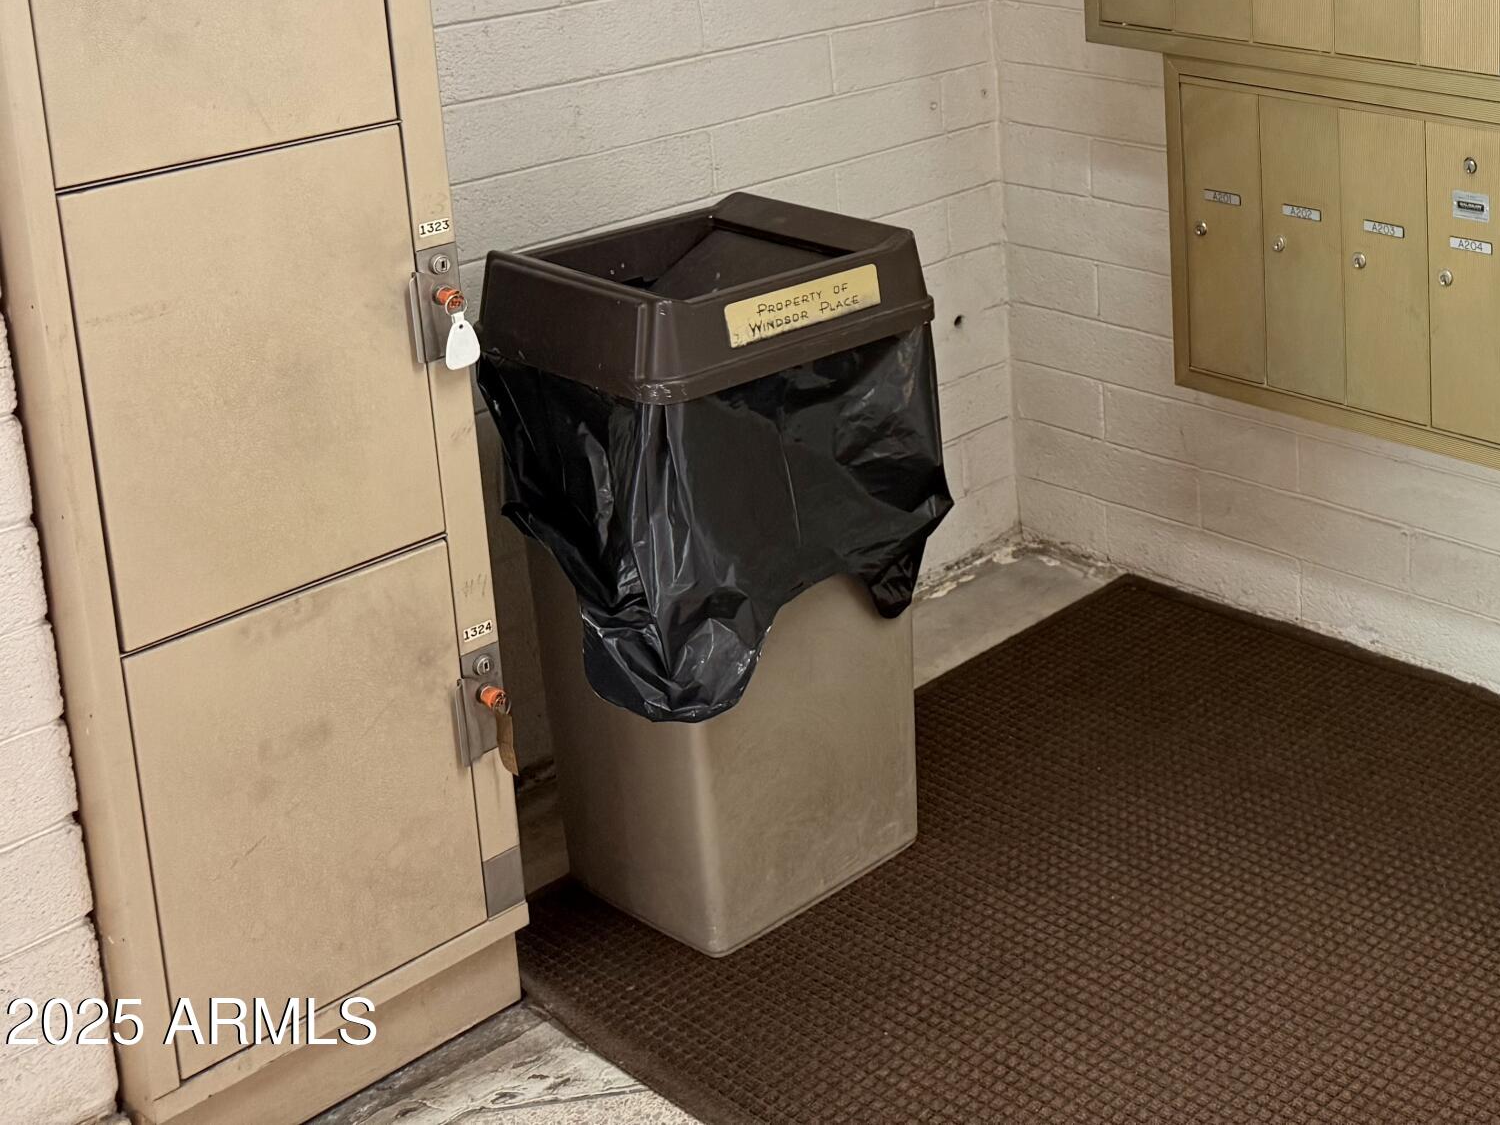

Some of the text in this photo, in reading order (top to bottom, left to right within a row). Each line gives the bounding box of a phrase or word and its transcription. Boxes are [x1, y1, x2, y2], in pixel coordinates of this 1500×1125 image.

[1212, 193, 1232, 204] A201
[1290, 207, 1313, 219] A202
[420, 220, 450, 235] 1323
[1372, 223, 1395, 236] A203
[1458, 240, 1483, 252] A204
[756, 283, 848, 317] PROPERTY OF
[748, 295, 860, 337] WINDSOR PLACE
[464, 622, 492, 640] 1324
